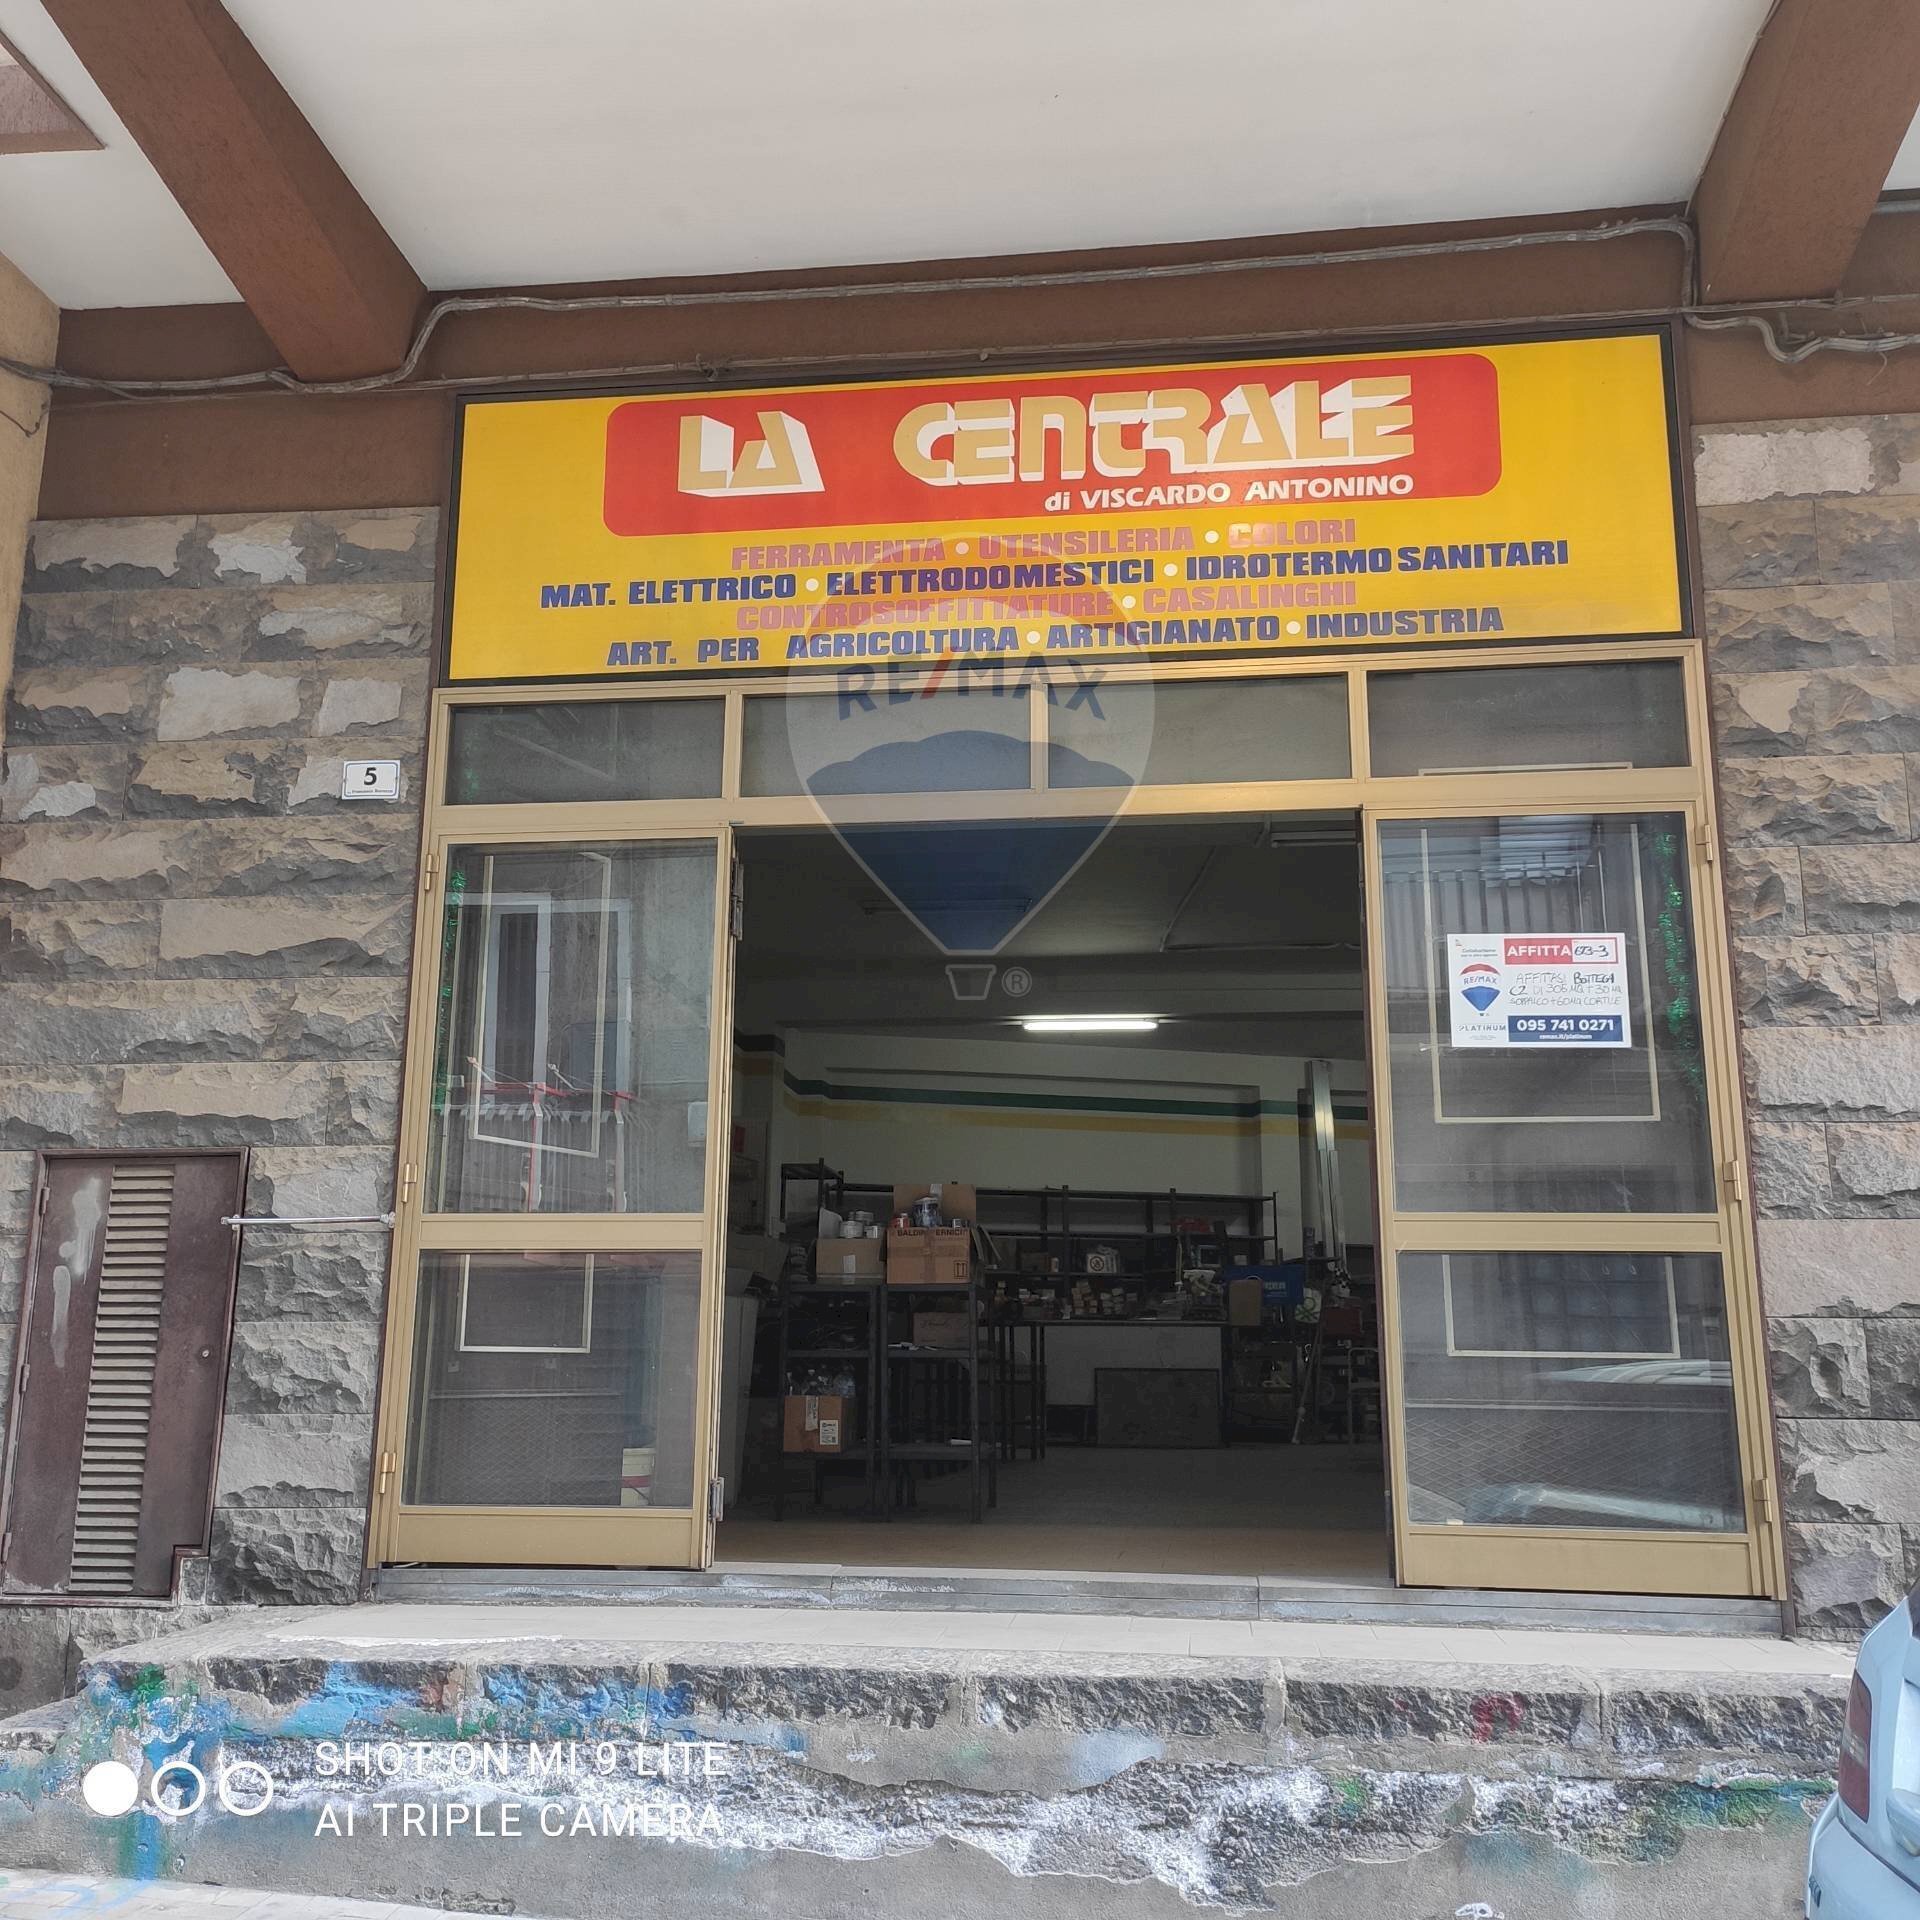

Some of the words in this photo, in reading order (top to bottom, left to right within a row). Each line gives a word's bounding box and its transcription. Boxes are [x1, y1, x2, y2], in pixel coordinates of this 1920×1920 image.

[678, 411, 826, 497] LA
[893, 374, 1414, 486] CENTRALE
[1044, 492, 1071, 512] di
[1080, 483, 1231, 510] VISCARDO
[1245, 474, 1414, 502] ANTONINO
[731, 537, 946, 570] FERRAMENTA
[978, 527, 1195, 560] UTENSILERIA
[1227, 519, 1357, 549] COLORI
[540, 583, 617, 609] MAT.
[628, 573, 796, 605] ELETTRICO
[826, 558, 1154, 596] ELETTRODOMESTICI
[1186, 548, 1393, 581] IDROTERMO
[1397, 540, 1569, 572] SANITARI
[736, 590, 1113, 631] CONTROSOFFITTATURE
[1142, 581, 1357, 615] CASALINGHI
[606, 641, 677, 667] ART.
[696, 637, 760, 662] PER
[785, 626, 1019, 660] AGRICOLTURA
[1046, 616, 1280, 650] ARTIGIANATO
[1305, 607, 1504, 640] INDUSTRIA
[364, 766, 377, 786] 5
[1507, 945, 1571, 957] AFFITTA
[1463, 975, 1498, 985] RE/MAX
[1573, 971, 1614, 984] BOTTEGA
[1516, 1019, 1546, 1031] 095
[1550, 1019, 1574, 1031] 741
[1578, 1019, 1614, 1031] 0271
